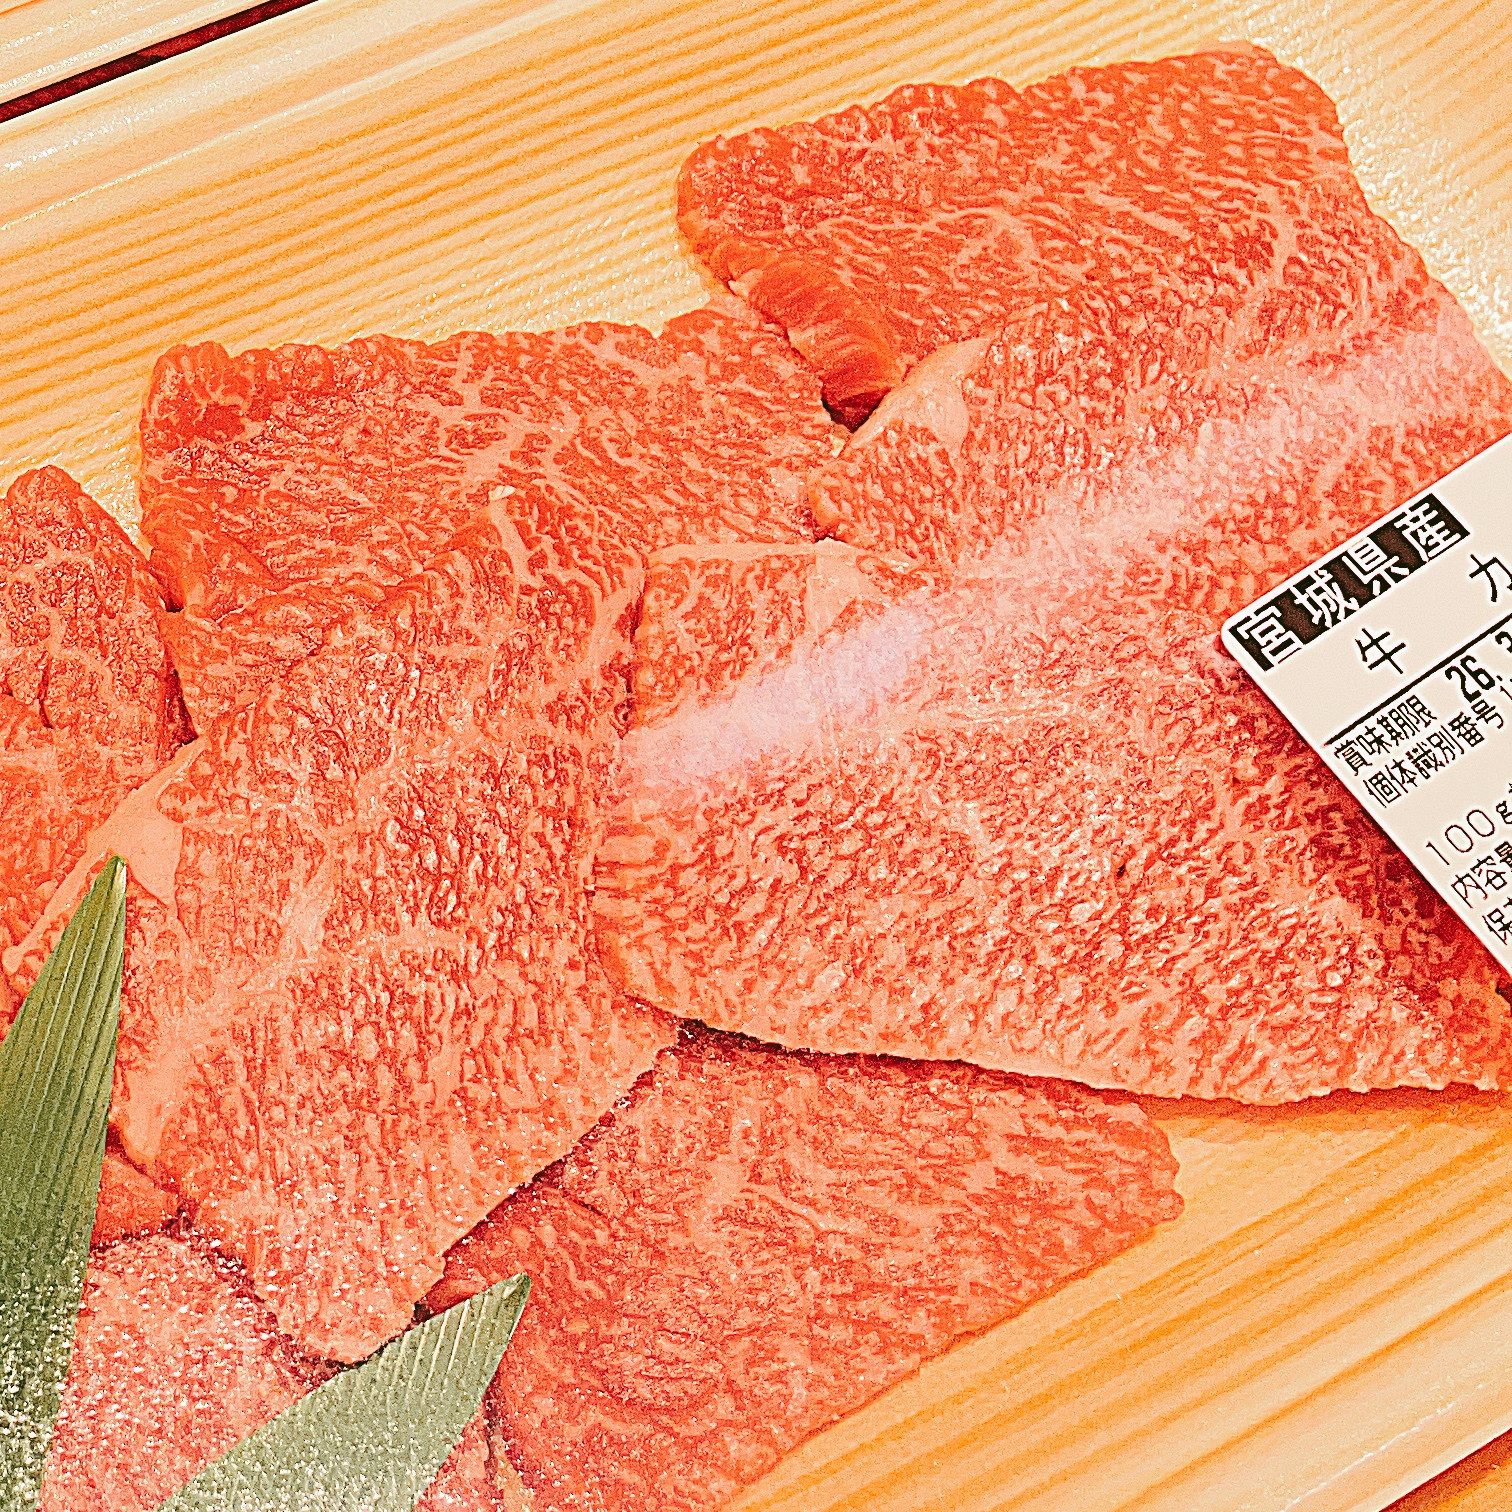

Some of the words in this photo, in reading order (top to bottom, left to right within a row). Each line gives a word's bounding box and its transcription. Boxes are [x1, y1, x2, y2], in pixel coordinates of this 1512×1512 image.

[1231, 495, 1468, 672] 宮城県産
[1333, 694, 1438, 777] 賞味期限
[1362, 698, 1505, 809] 個体識別番号
